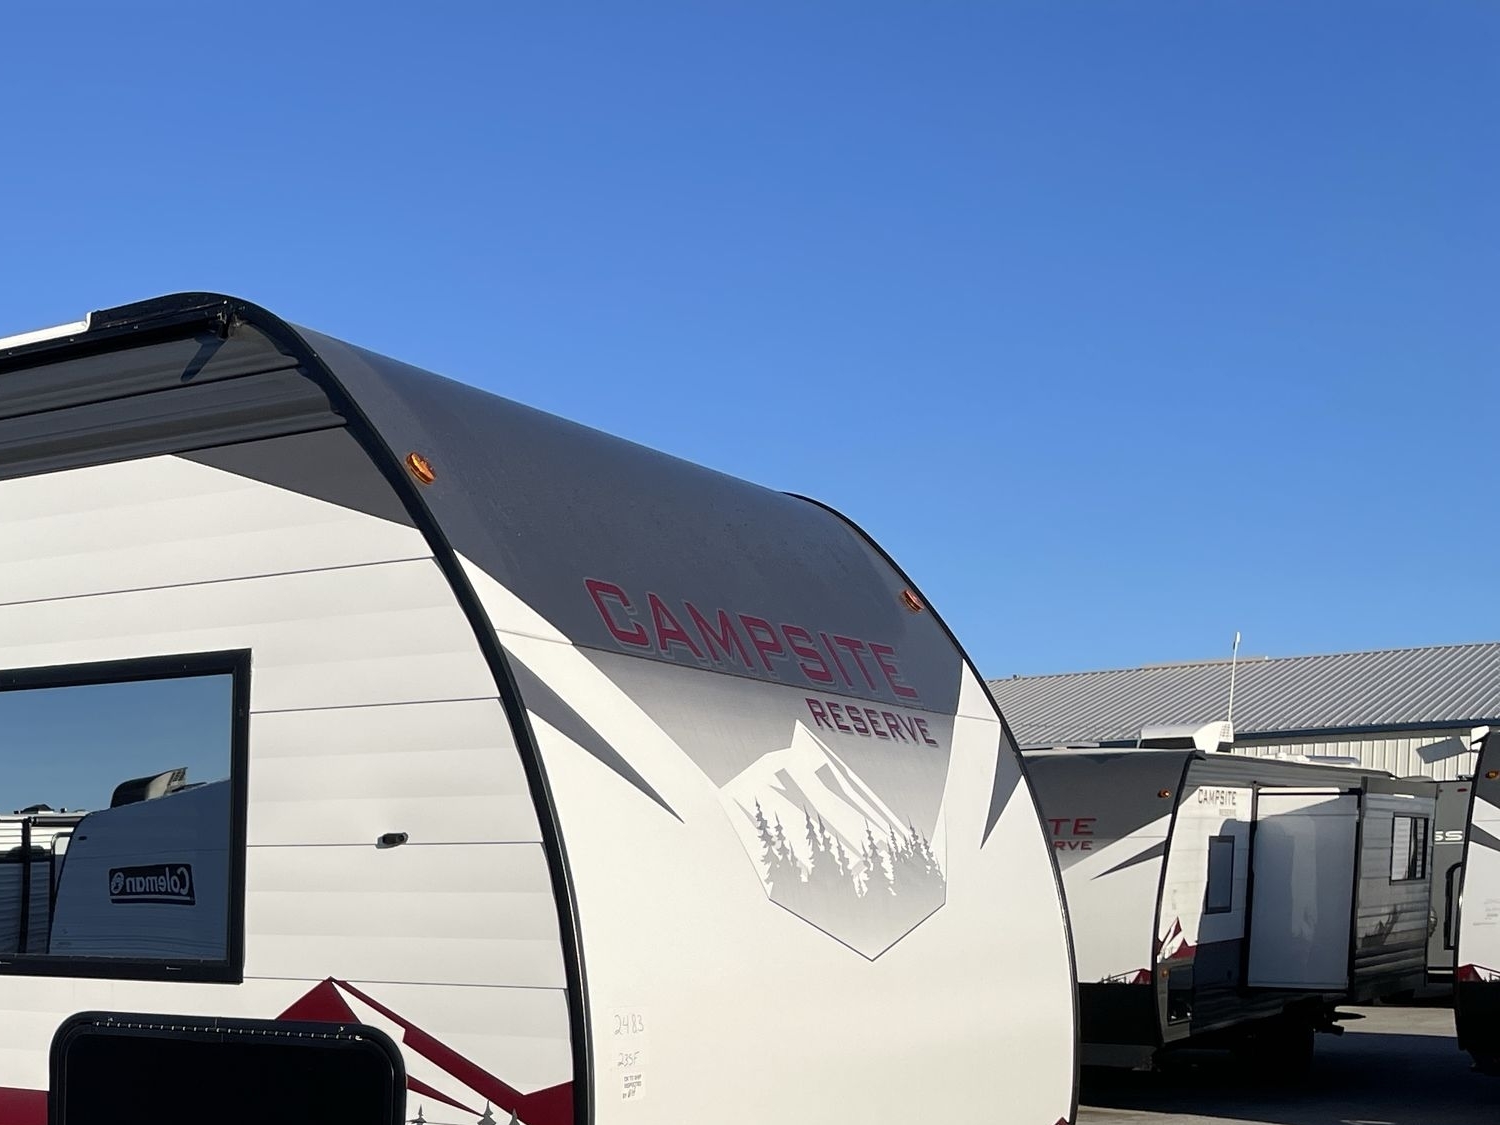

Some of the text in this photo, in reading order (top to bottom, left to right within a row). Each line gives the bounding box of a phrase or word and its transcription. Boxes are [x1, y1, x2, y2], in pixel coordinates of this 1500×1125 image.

[584, 577, 920, 699] CAMPSITE
[805, 697, 939, 747] RESERVE
[1197, 789, 1237, 806] CAMPSITE
[614, 1014, 644, 1035] 2483
